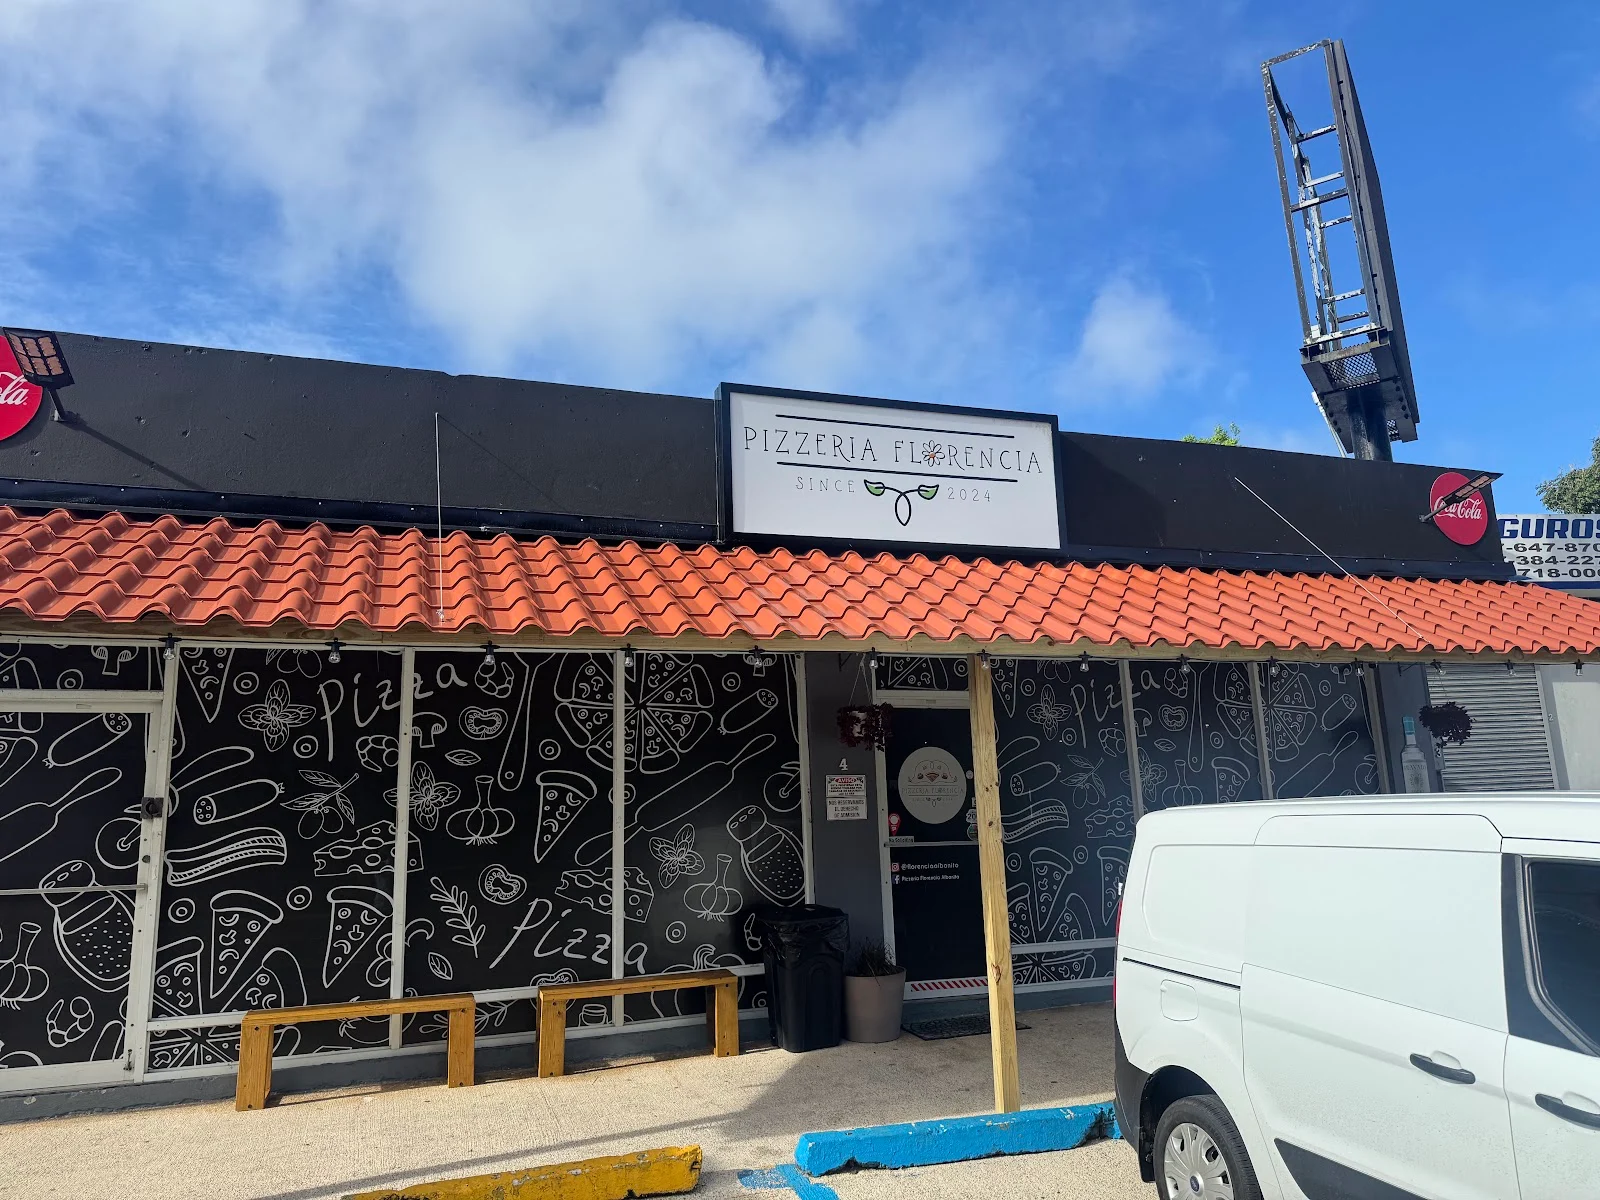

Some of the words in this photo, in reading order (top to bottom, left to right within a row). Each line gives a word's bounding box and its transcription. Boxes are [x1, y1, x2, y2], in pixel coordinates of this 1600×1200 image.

[743, 426, 878, 463] PIZZERIA
[894, 439, 1043, 474] FLORENCIA
[795, 476, 855, 493] SINCE
[946, 486, 991, 502] 2024
[1497, 518, 1600, 539] GURO
[1517, 568, 1600, 578] 718-00
[838, 757, 849, 771] 4
[901, 787, 929, 795] PIZZERIA
